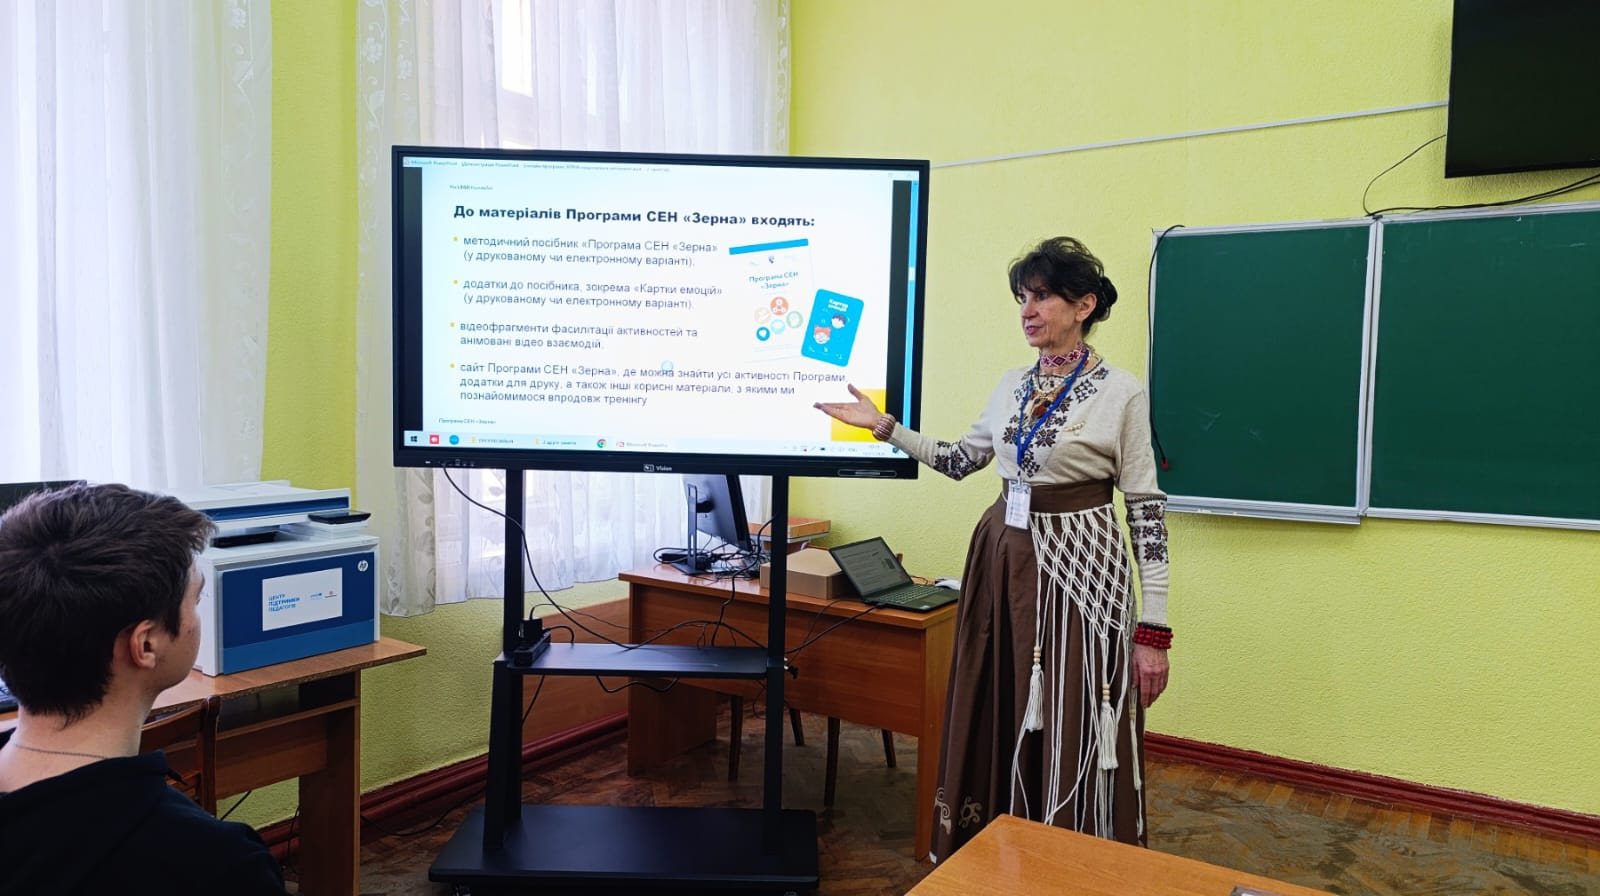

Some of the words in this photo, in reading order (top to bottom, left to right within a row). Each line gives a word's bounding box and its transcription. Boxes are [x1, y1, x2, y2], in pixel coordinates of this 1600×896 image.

[454, 205, 474, 218] До
[479, 207, 562, 222] матеріалів
[566, 209, 641, 223] Програми
[646, 211, 678, 223] СЕН
[683, 212, 746, 226] «Зерна»
[751, 216, 815, 228] входять:
[463, 236, 530, 248] методичний
[532, 236, 578, 249] посібник
[582, 239, 641, 252] «Програма
[644, 240, 670, 252] СЕН
[673, 241, 718, 254] «Зерна»
[463, 250, 474, 262] (у
[476, 252, 546, 264] друкованому
[550, 254, 563, 262] чи
[566, 254, 642, 266] електронному
[463, 279, 508, 290] додатки
[510, 280, 524, 290] до
[586, 284, 630, 294] зокрема
[634, 284, 678, 295] «Картки
[680, 285, 722, 296] емоцій»
[464, 293, 474, 305] (у
[476, 295, 546, 306] друкованому
[550, 296, 563, 304] чи
[565, 296, 642, 309] електронному
[460, 322, 548, 334] відеофрагменти
[551, 324, 614, 336] фасилітації
[616, 326, 683, 338] активностей
[686, 328, 698, 338] та
[460, 336, 512, 346] анімовані
[514, 338, 544, 348] відео
[460, 362, 485, 372] сайт
[488, 363, 542, 375] Програми
[544, 364, 568, 375] СЕН
[622, 368, 637, 378] де
[640, 368, 674, 378] можна
[678, 368, 714, 378] знайти
[716, 370, 730, 381] усі
[734, 370, 790, 381] активності
[460, 377, 504, 388] додатки
[506, 378, 526, 388] для
[576, 382, 606, 390] також
[610, 382, 631, 390] інші
[634, 382, 674, 393] корисні
[736, 386, 742, 394] з
[745, 386, 778, 394] якими
[780, 386, 795, 394] ми
[460, 390, 545, 402] познайомимося
[548, 393, 600, 404] впродовж
[604, 395, 648, 406] тренінгу
